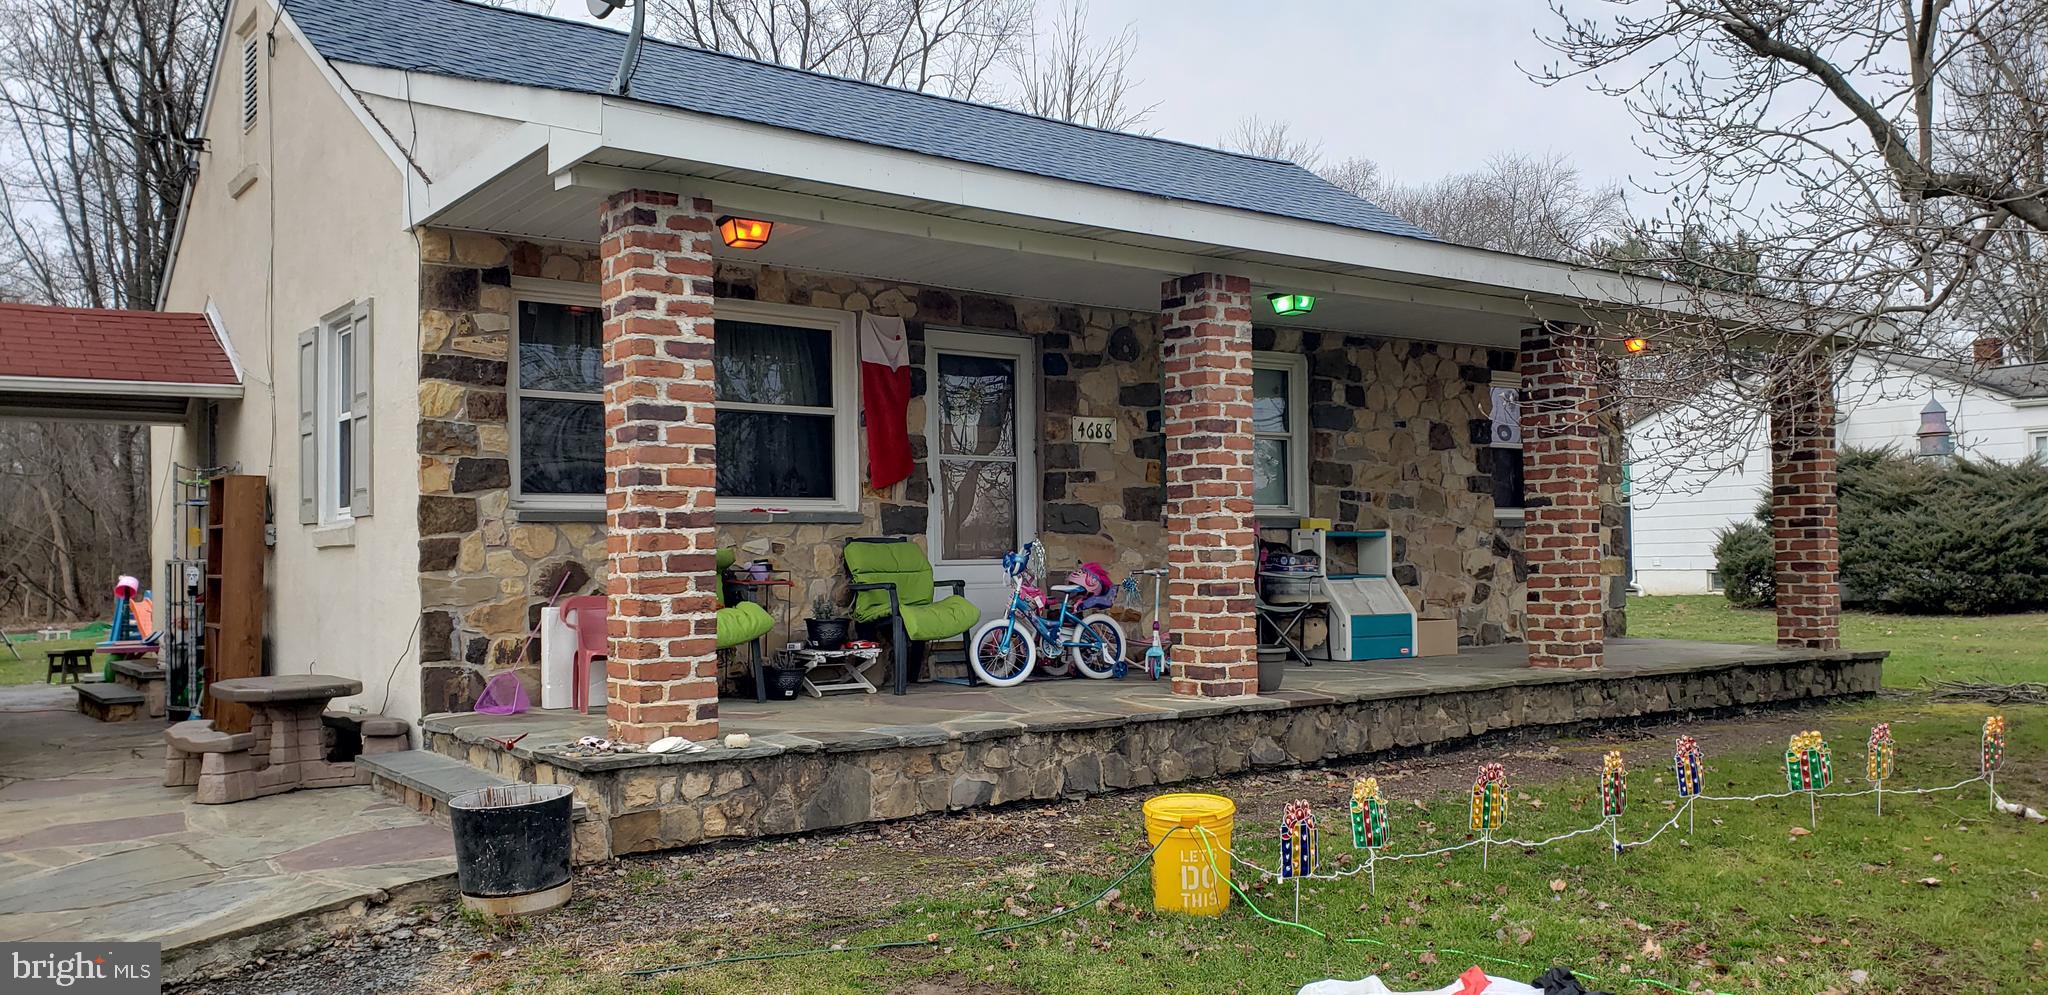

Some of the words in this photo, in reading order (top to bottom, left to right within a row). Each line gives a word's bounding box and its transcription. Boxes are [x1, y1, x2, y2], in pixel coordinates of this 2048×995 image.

[1078, 421, 1112, 440] 4688
[1180, 848, 1218, 863] LETS
[1181, 864, 1218, 890] DO
[1180, 892, 1219, 908] THIS
